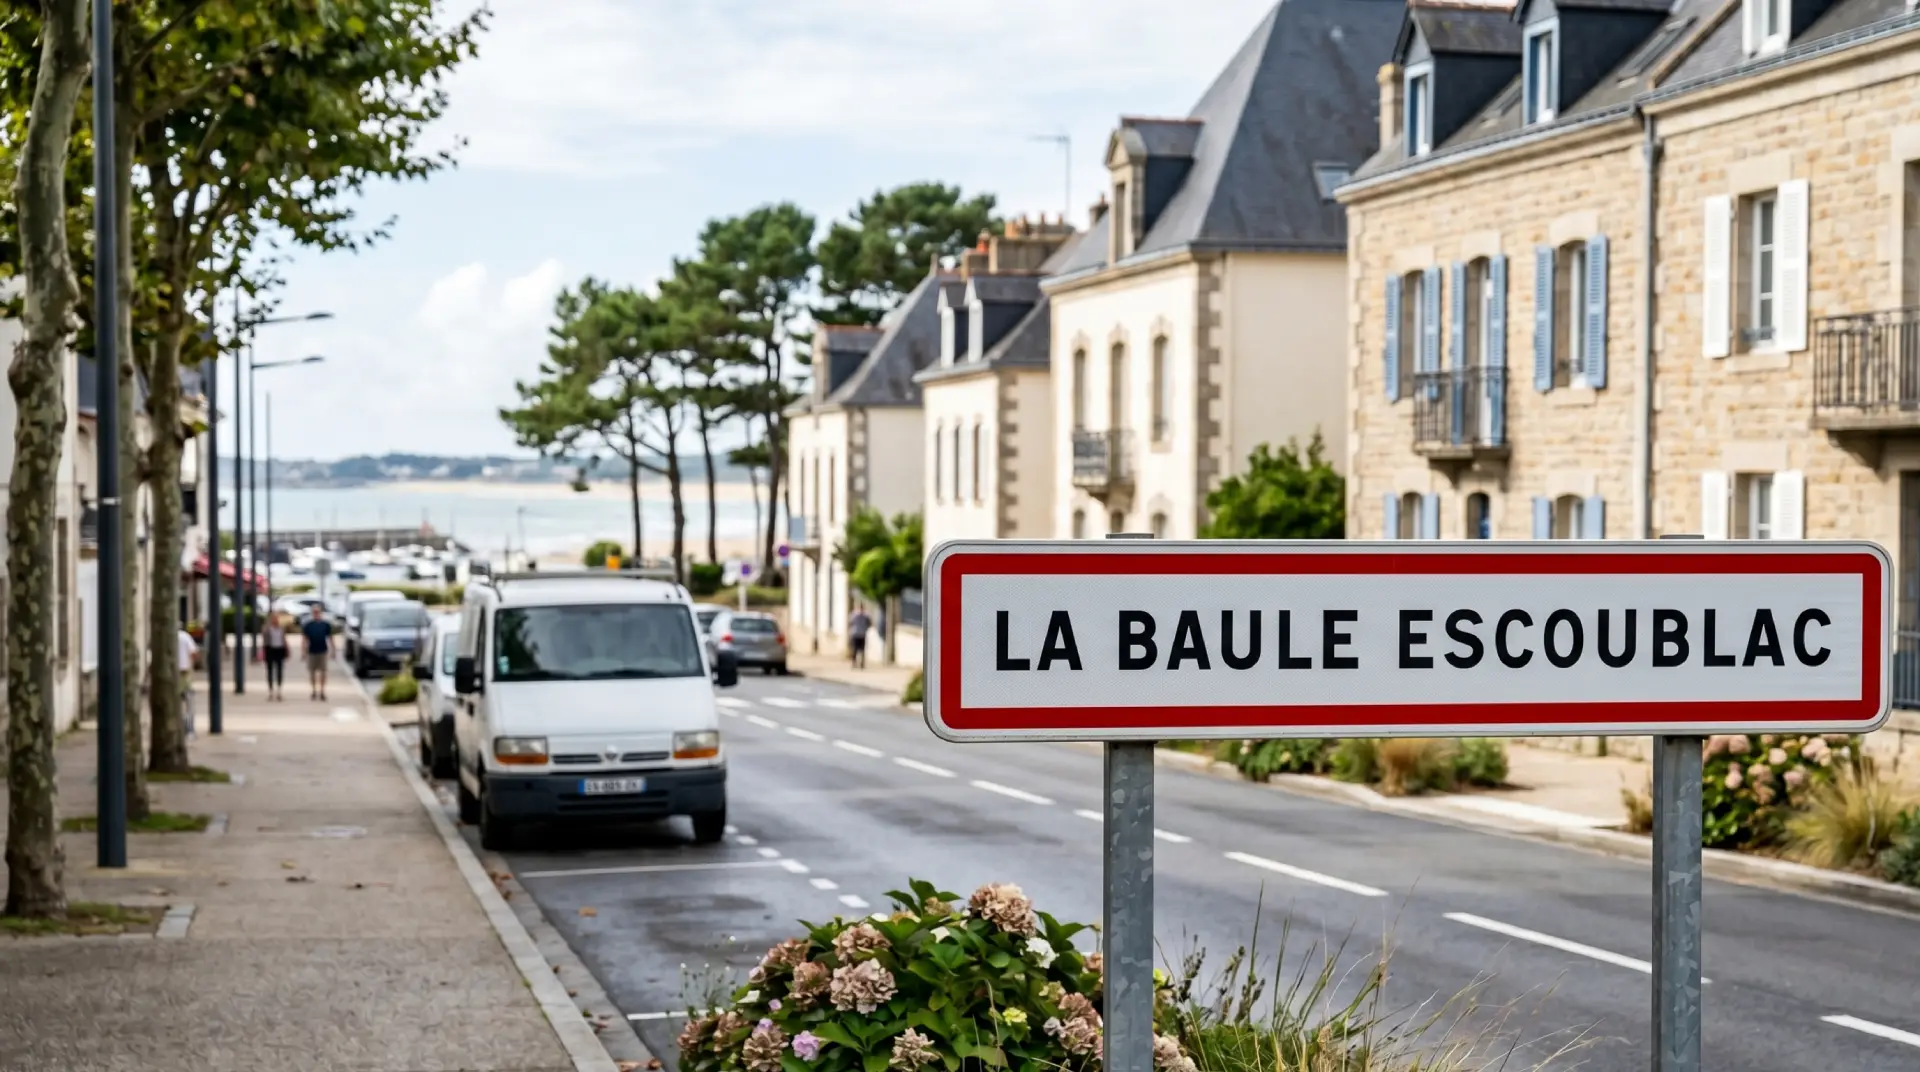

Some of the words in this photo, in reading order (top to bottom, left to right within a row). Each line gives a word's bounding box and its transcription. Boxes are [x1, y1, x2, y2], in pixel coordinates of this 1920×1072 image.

[996, 610, 1083, 671] LA
[1118, 609, 1359, 671] BAULE
[1398, 607, 1833, 669] ESCOUBLAC
